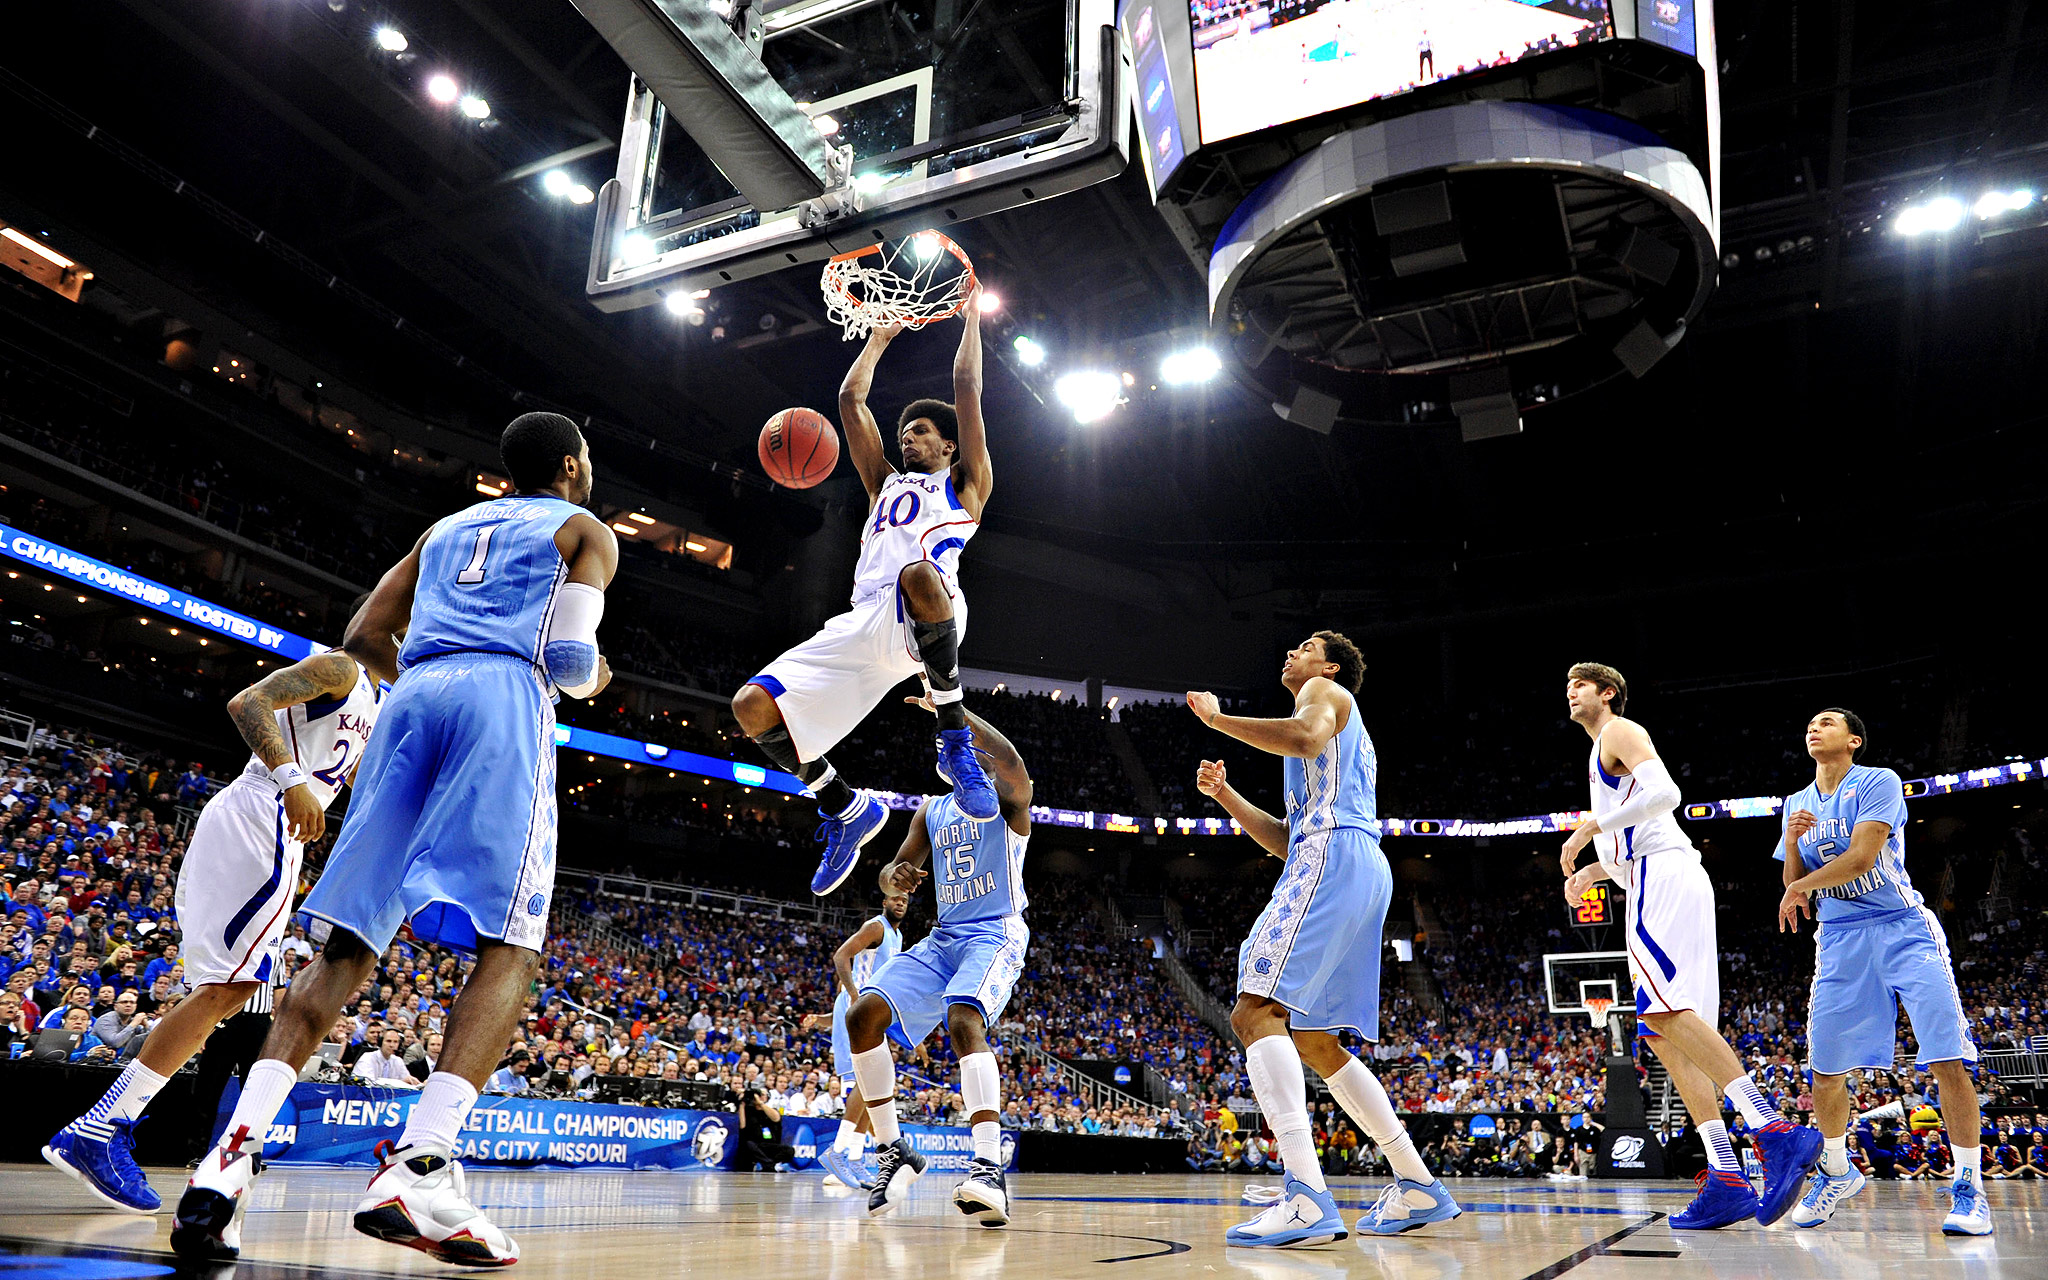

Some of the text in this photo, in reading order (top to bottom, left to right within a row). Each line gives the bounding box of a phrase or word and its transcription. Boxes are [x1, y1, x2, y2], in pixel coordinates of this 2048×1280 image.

[871, 490, 921, 536] 40
[456, 524, 501, 585] 1
[12, 536, 171, 607] CHAMPIONSHIP
[183, 600, 258, 640] HOSTED
[258, 627, 285, 649] BY
[337, 713, 372, 743] KANS
[312, 739, 360, 794] 24
[1904, 783, 1914, 796] 2
[934, 819, 981, 849] NORTH
[943, 844, 977, 882] 15
[1817, 842, 1840, 863] 5
[937, 871, 997, 905] CAROLINA
[1577, 900, 1604, 923] 22
[322, 1099, 402, 1128] MEN'S
[553, 1113, 688, 1141] CHAMPIONSHIP
[549, 1142, 628, 1164] MISSOURI
[914, 1133, 947, 1151] THIRD
